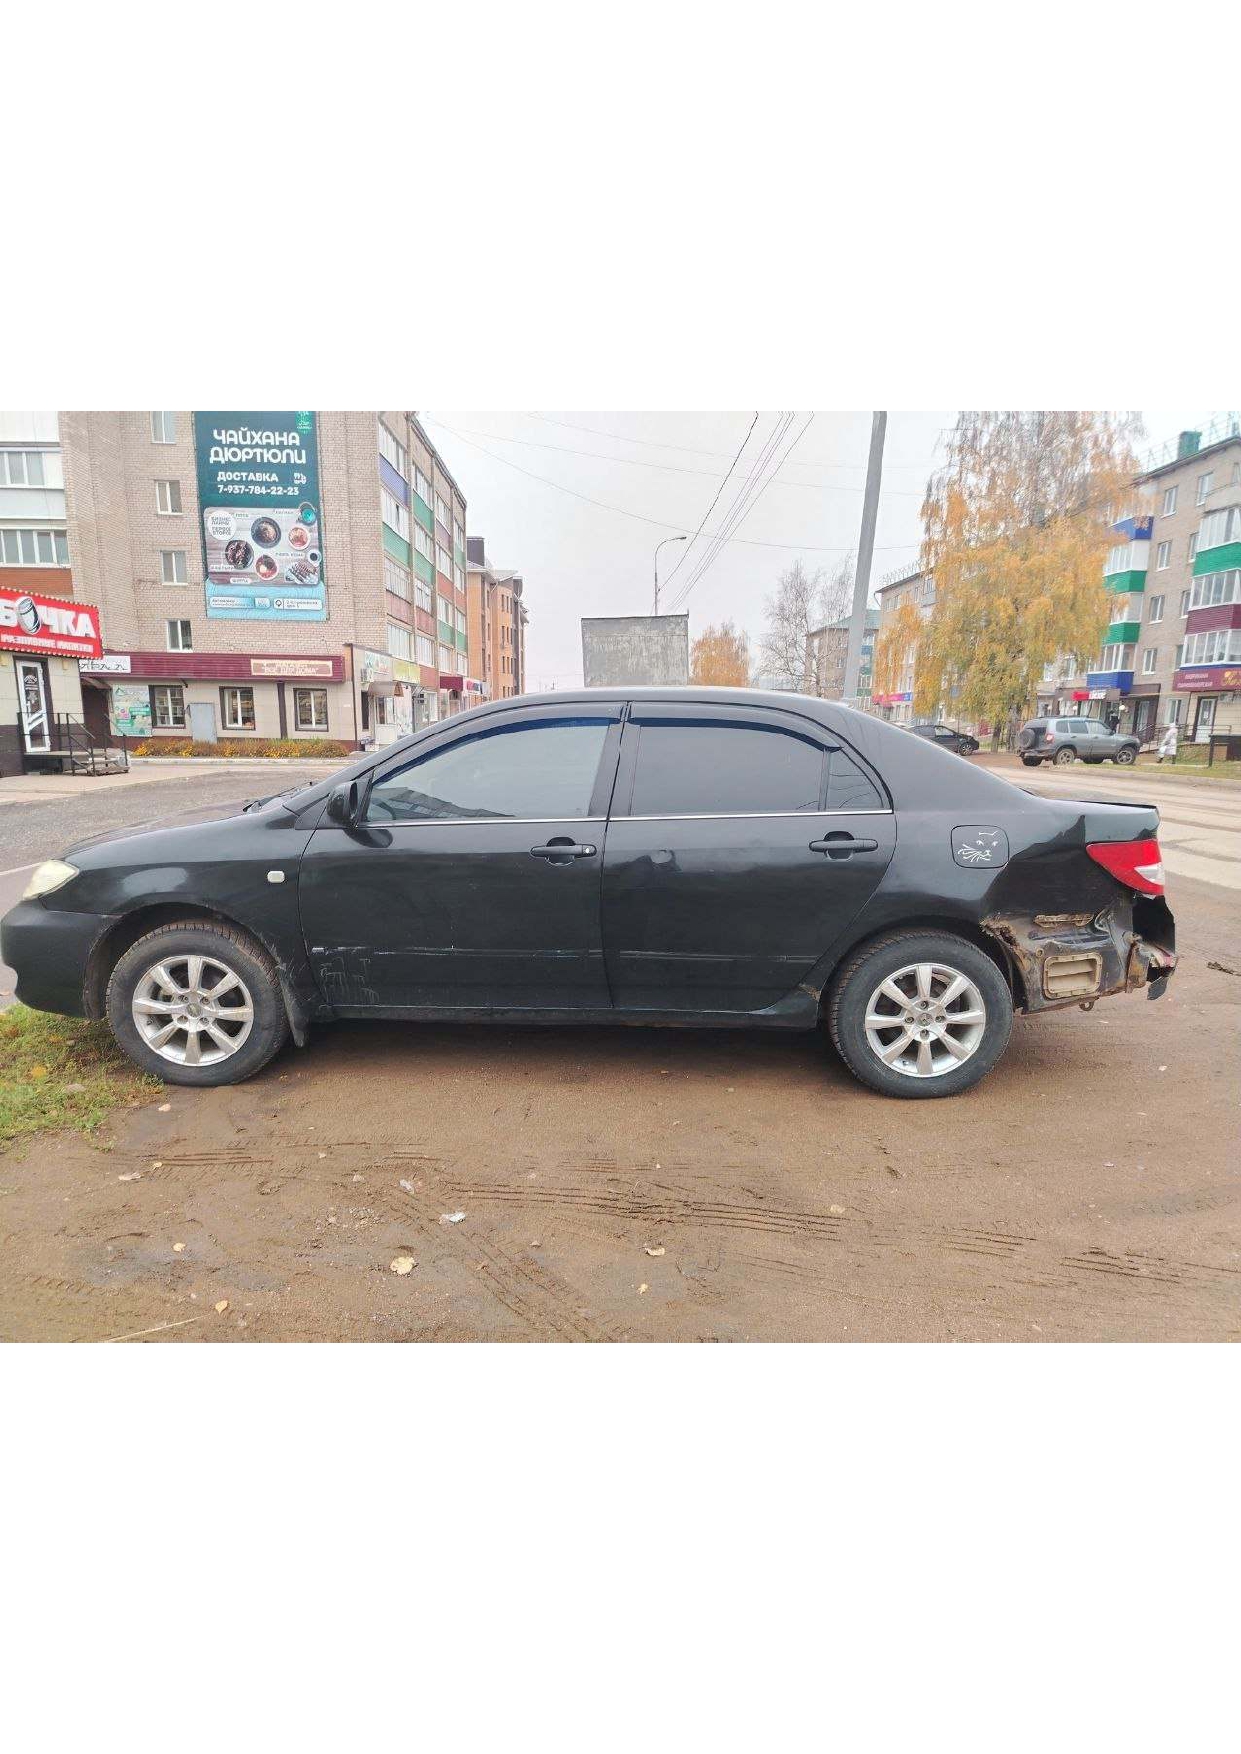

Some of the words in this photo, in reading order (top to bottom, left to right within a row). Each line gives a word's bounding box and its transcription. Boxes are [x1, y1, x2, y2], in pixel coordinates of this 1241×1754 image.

[213, 427, 300, 446] ЧАЙХАНА
[209, 446, 306, 464] ДЮРТЮЛИ
[217, 472, 278, 482] ДОСТАВКА
[217, 485, 299, 496] 7-937-784-22-23
